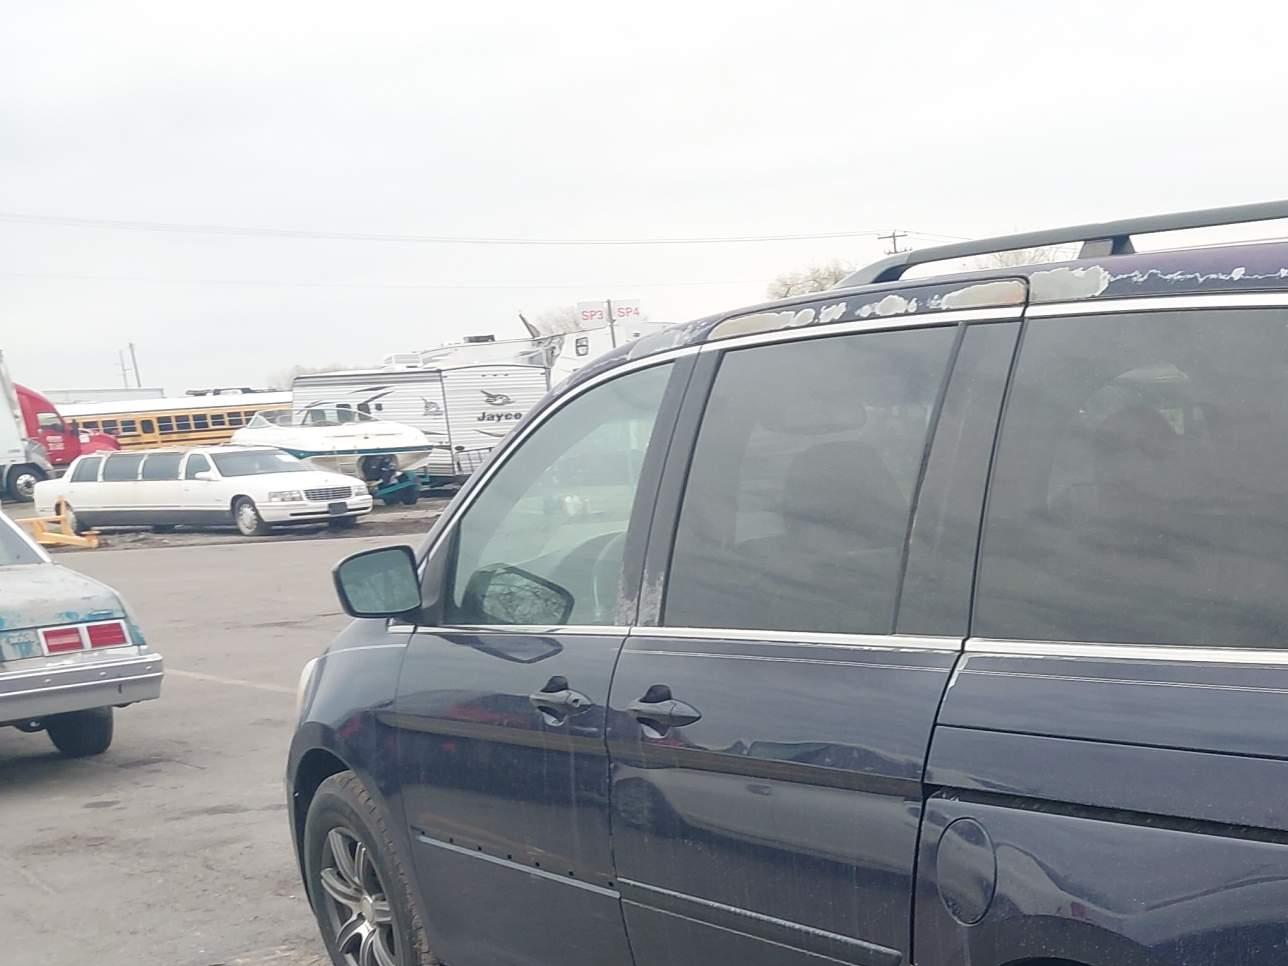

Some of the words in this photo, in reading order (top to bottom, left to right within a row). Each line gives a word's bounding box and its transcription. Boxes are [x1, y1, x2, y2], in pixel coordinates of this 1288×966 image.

[581, 310, 604, 321] SP3
[616, 307, 640, 318] SP4
[476, 411, 523, 423] Jayco
